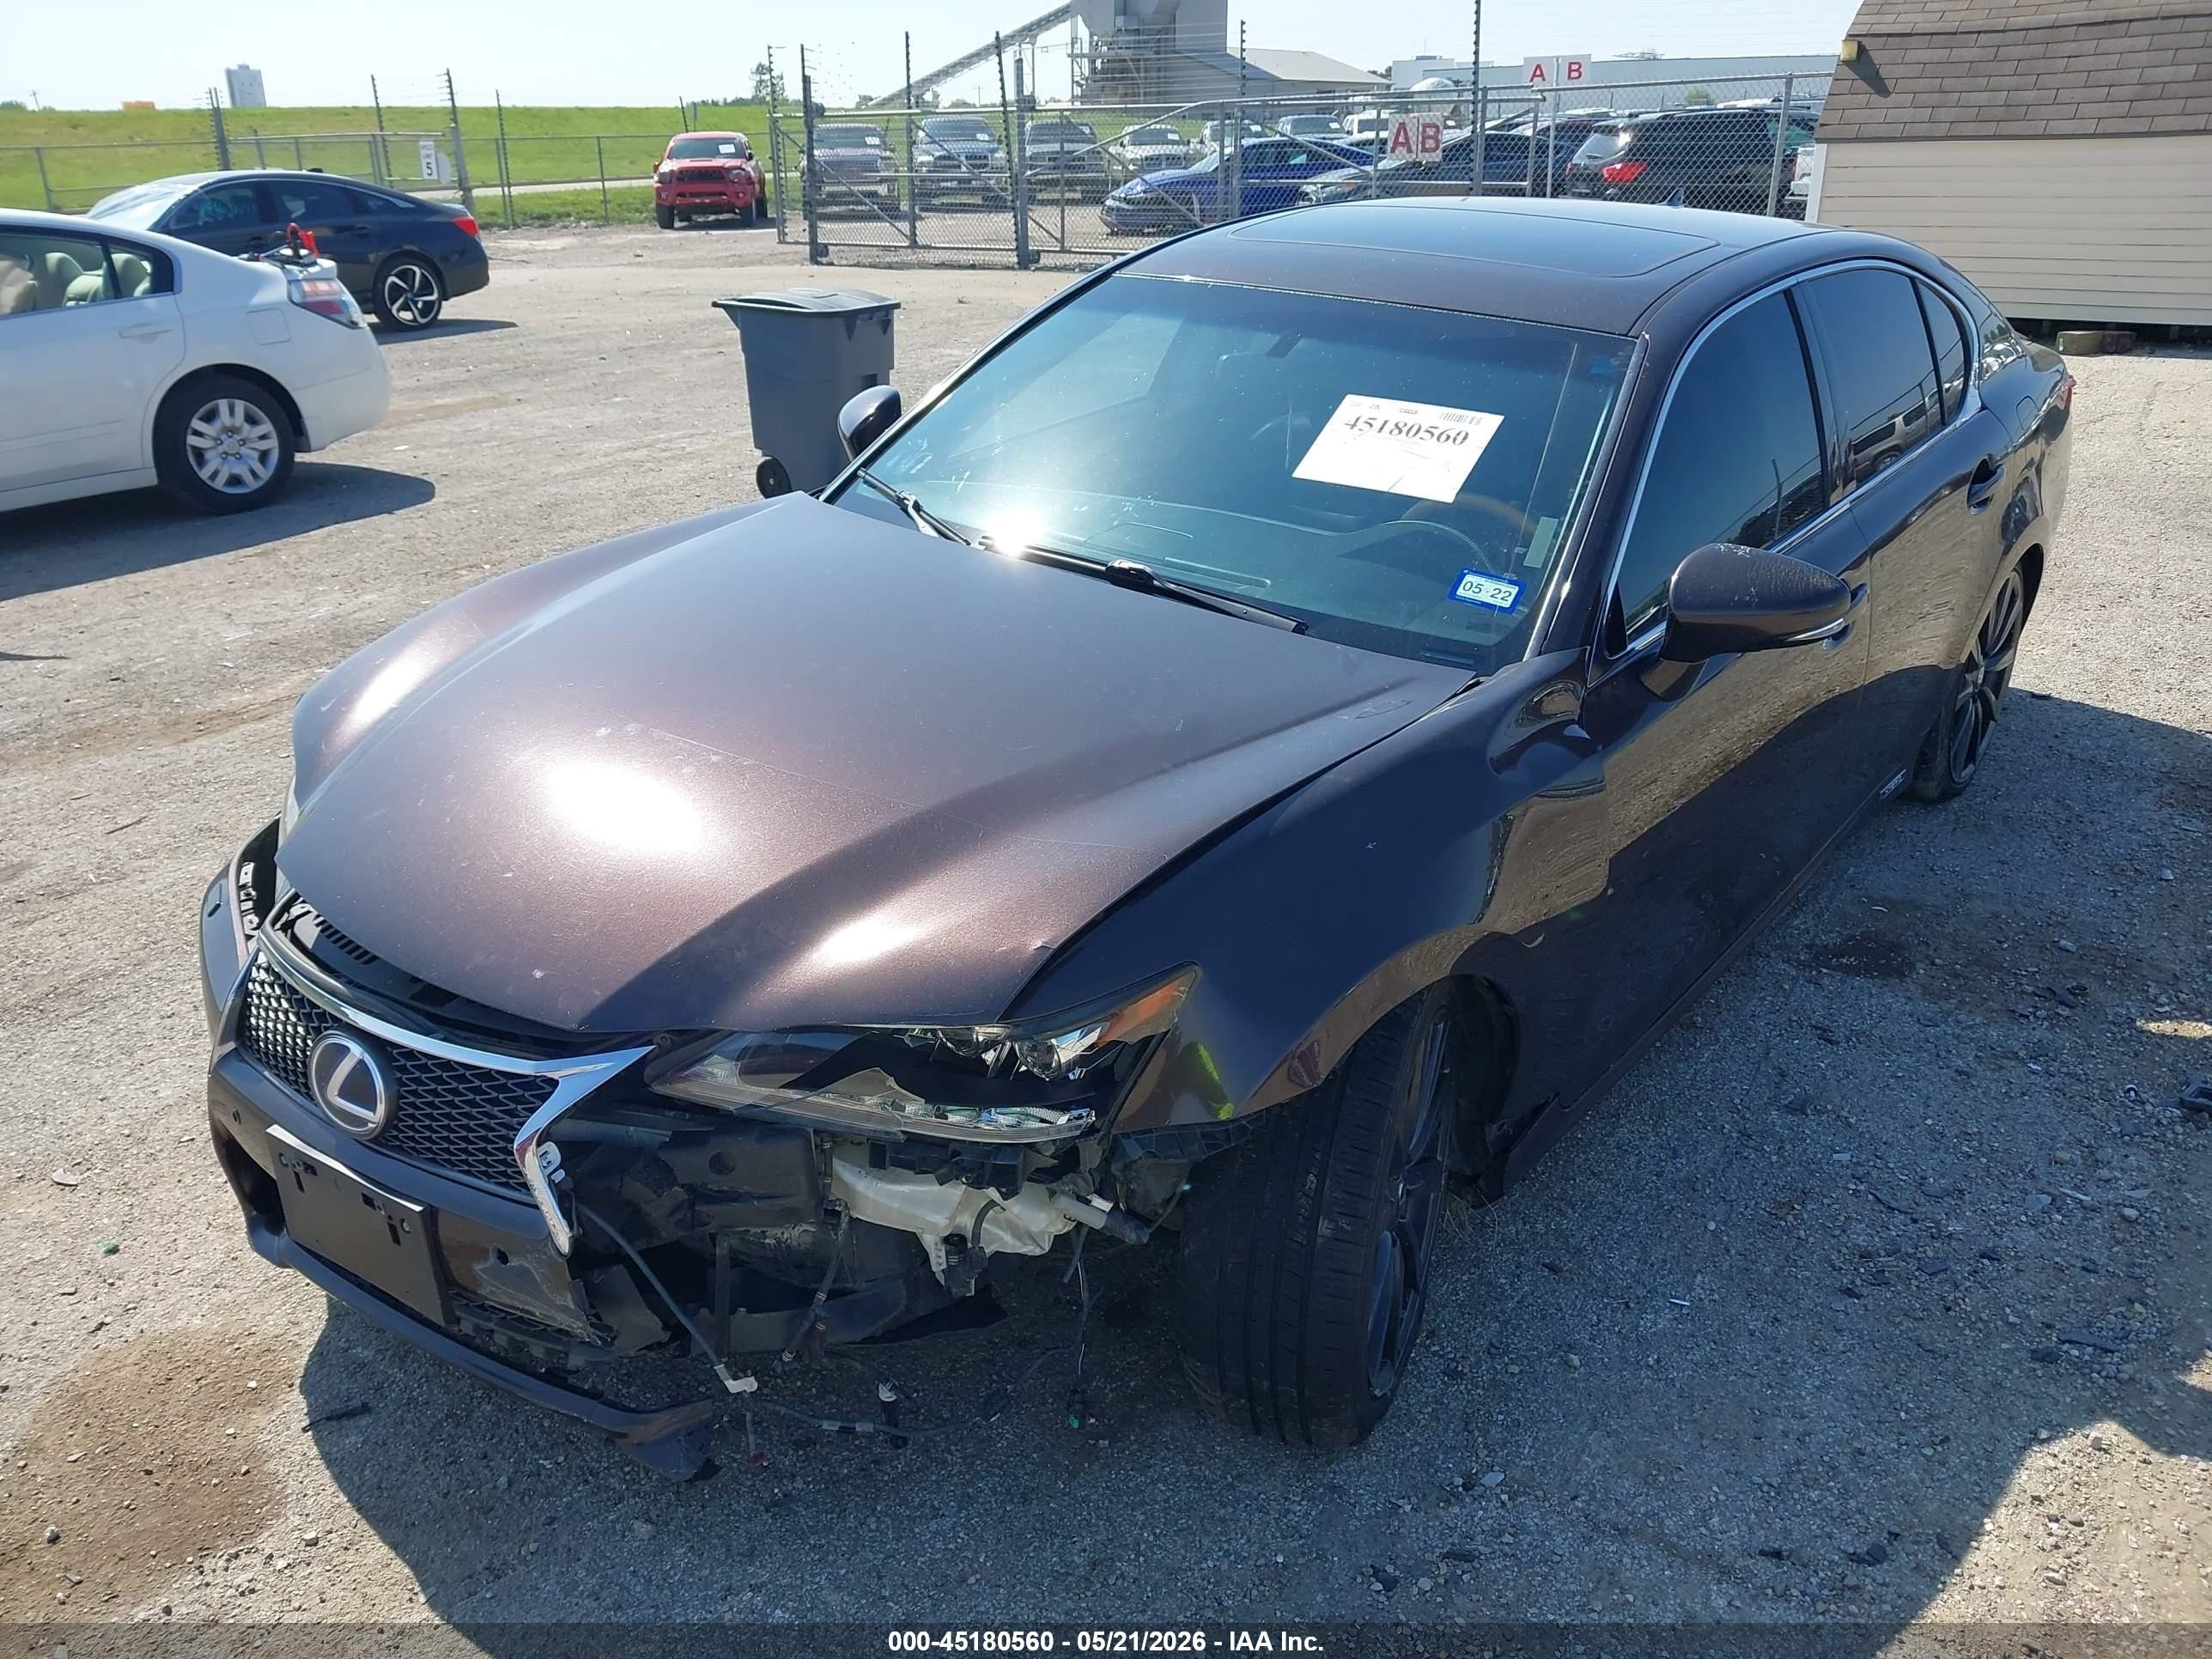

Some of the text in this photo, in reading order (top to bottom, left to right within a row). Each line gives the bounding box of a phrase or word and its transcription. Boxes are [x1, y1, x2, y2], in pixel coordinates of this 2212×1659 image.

[1529, 62, 1582, 82] A B
[1390, 122, 1440, 153] A B
[425, 161, 433, 176] 5
[1344, 415, 1469, 446] 45180560
[1462, 580, 1484, 594] 05
[1489, 587, 1512, 602] 22
